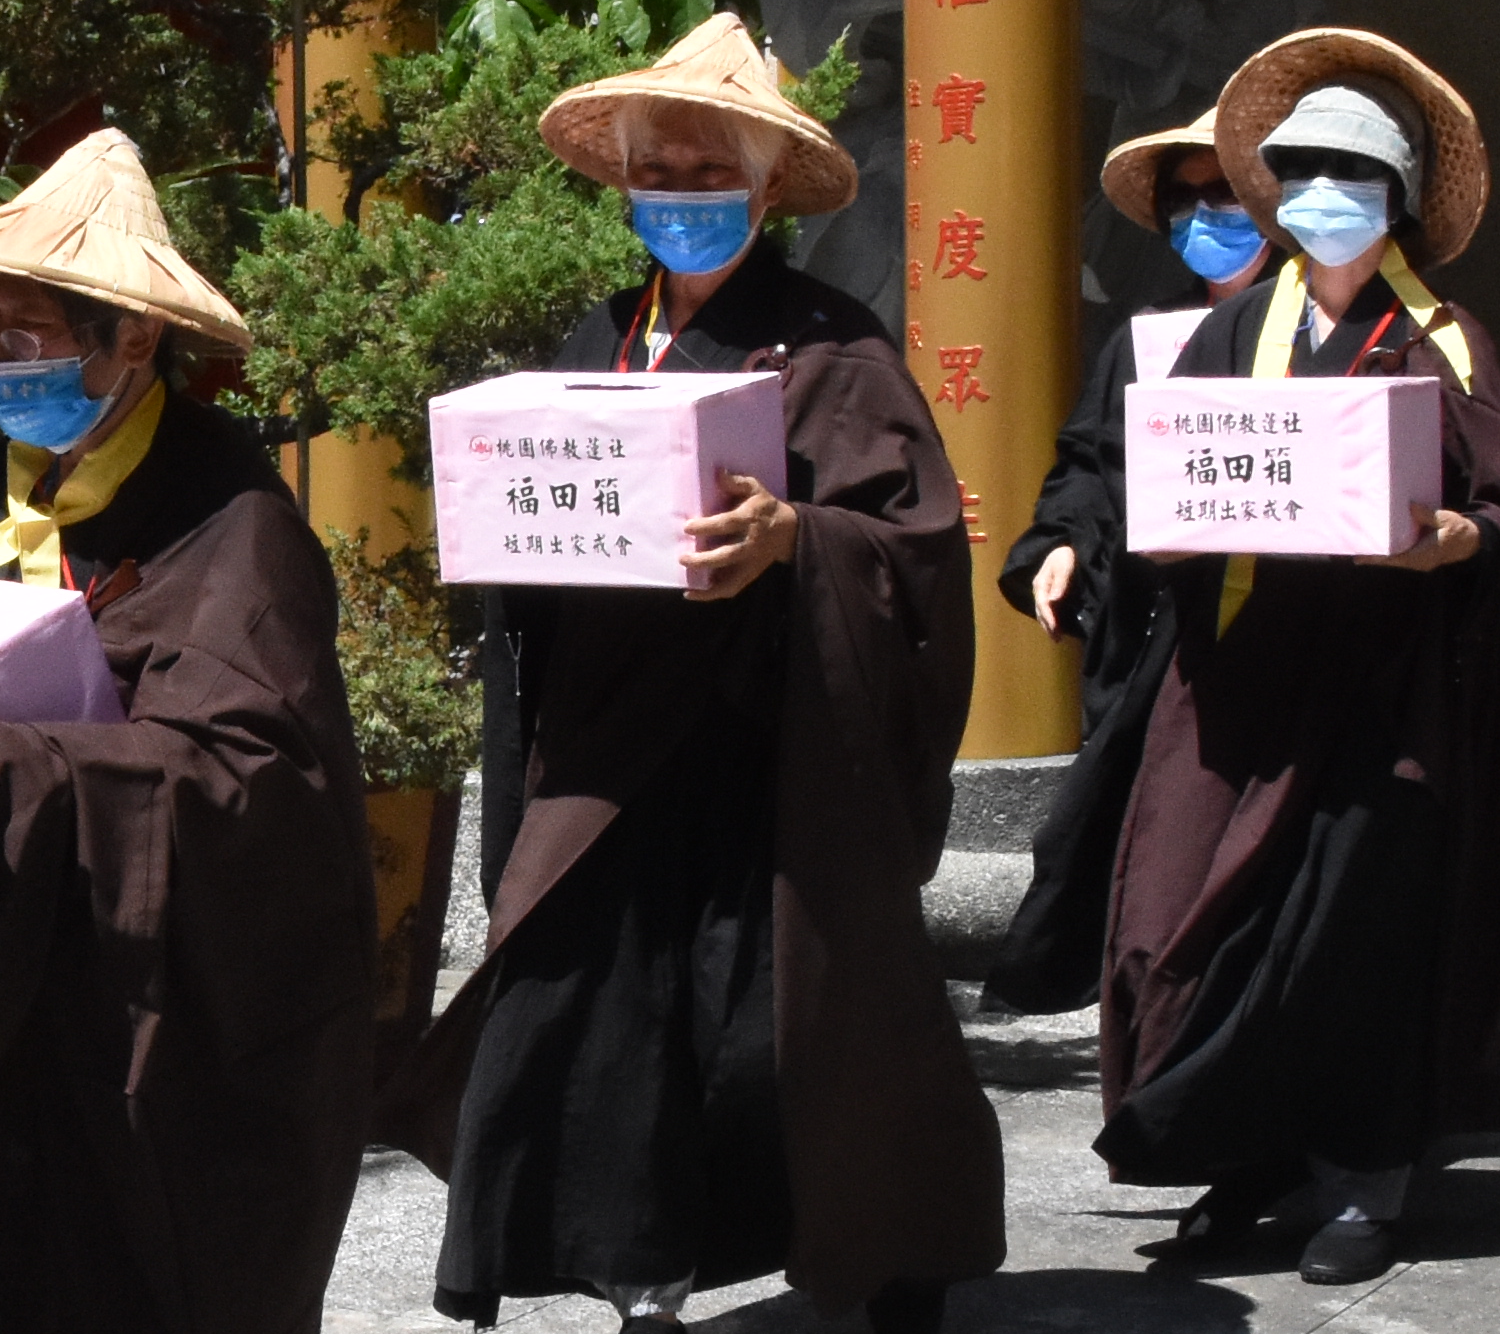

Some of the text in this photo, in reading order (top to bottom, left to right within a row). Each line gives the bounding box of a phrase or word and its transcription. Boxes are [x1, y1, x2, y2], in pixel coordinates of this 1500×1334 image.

[1184, 446, 1293, 486] 福田箱
[505, 477, 622, 517] 福田箱
